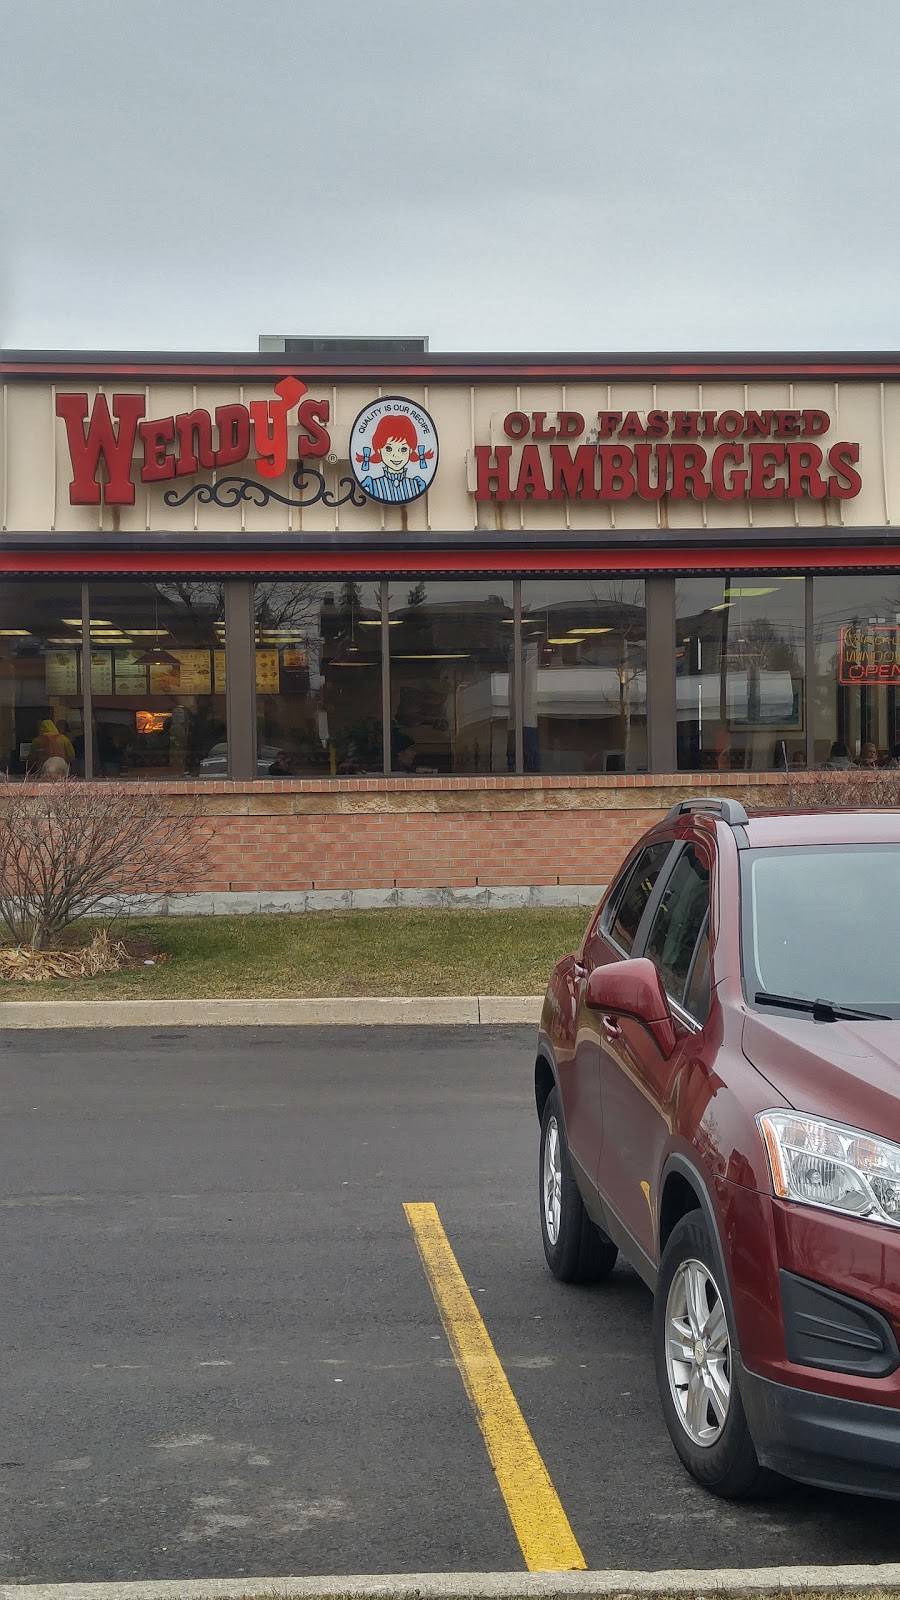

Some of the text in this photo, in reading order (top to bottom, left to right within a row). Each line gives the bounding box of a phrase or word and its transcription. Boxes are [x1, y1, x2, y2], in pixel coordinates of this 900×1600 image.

[358, 404, 431, 435] QUALITY IS OUR RECIPE
[503, 409, 831, 440] OLD FASHIONED
[474, 441, 862, 501] HAMBURGERS
